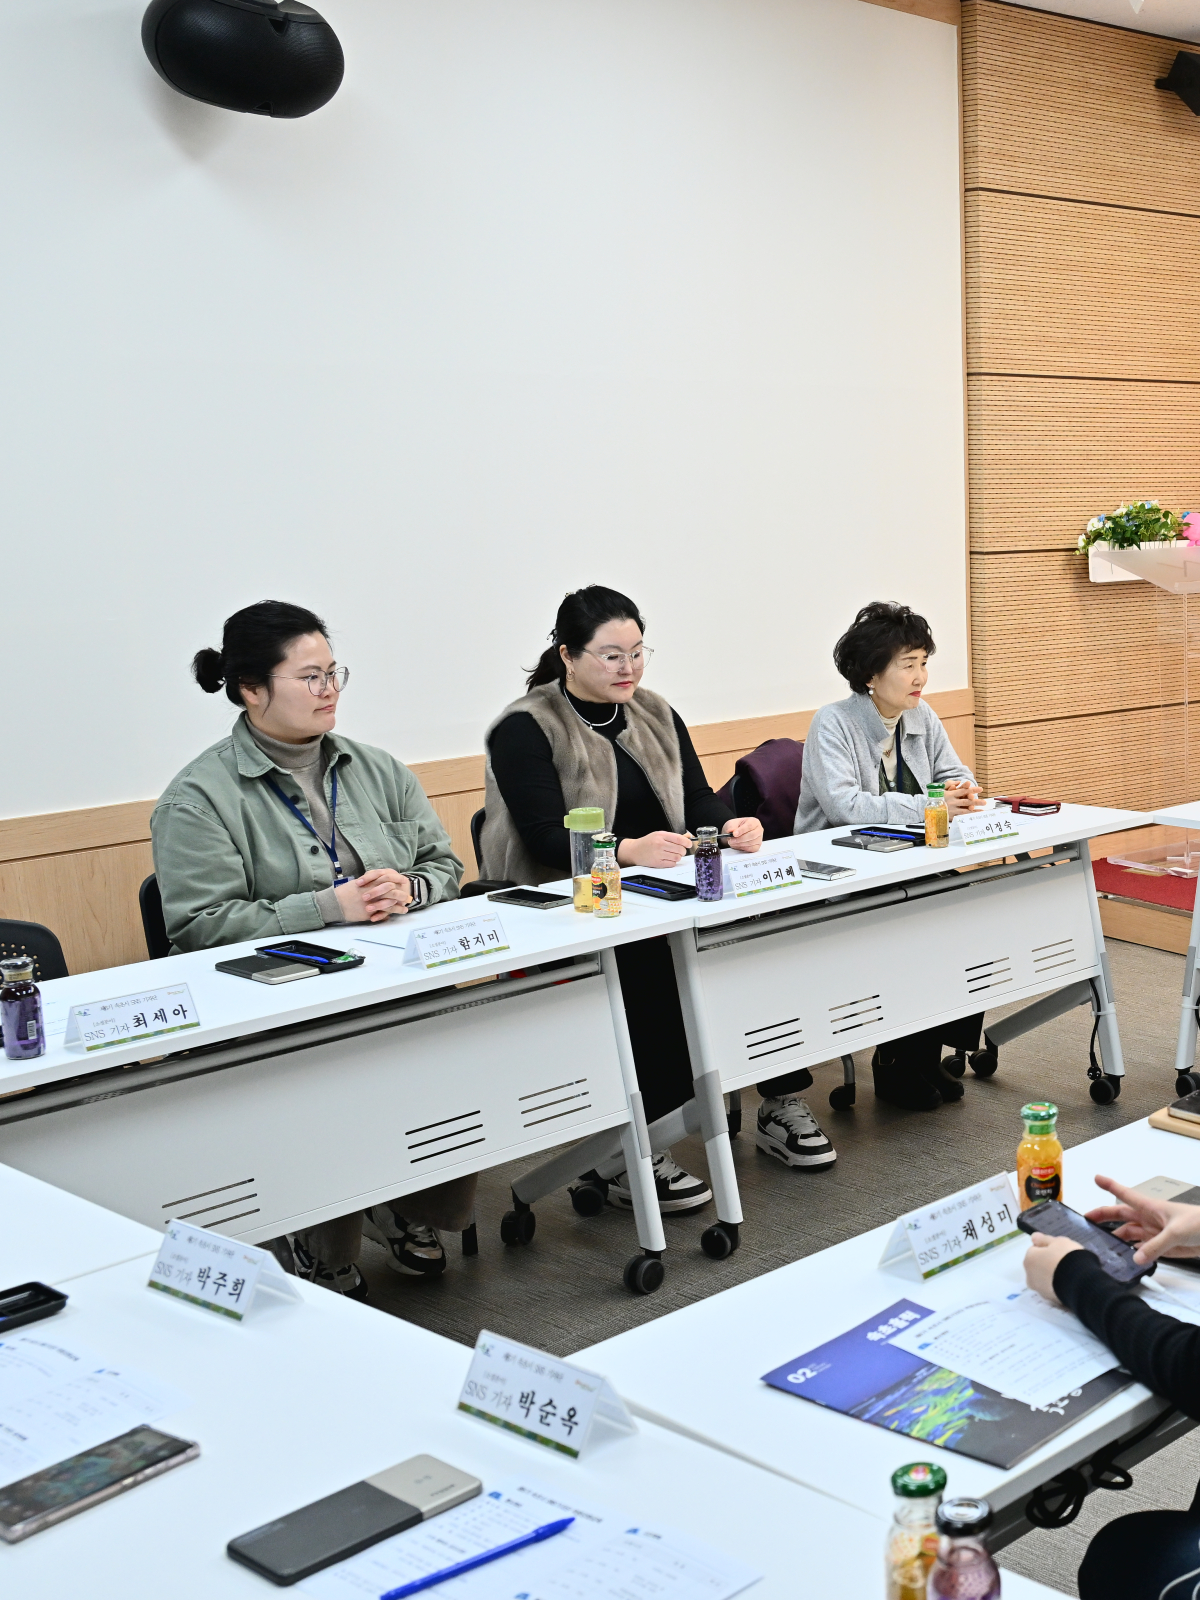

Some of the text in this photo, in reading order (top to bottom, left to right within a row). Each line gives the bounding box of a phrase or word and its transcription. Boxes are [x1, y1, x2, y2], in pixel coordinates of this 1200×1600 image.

[424, 950, 440, 960] SNS
[443, 945, 457, 956] 기자
[84, 1029, 105, 1042] SNS
[110, 1023, 130, 1035] 기자
[918, 1247, 939, 1266] SNS
[942, 1236, 962, 1253] 기자
[154, 1261, 173, 1277] SNS
[175, 1268, 192, 1285] 기자
[787, 1368, 818, 1384] 02
[464, 1380, 488, 1400] SNS
[490, 1390, 513, 1411] 기자
